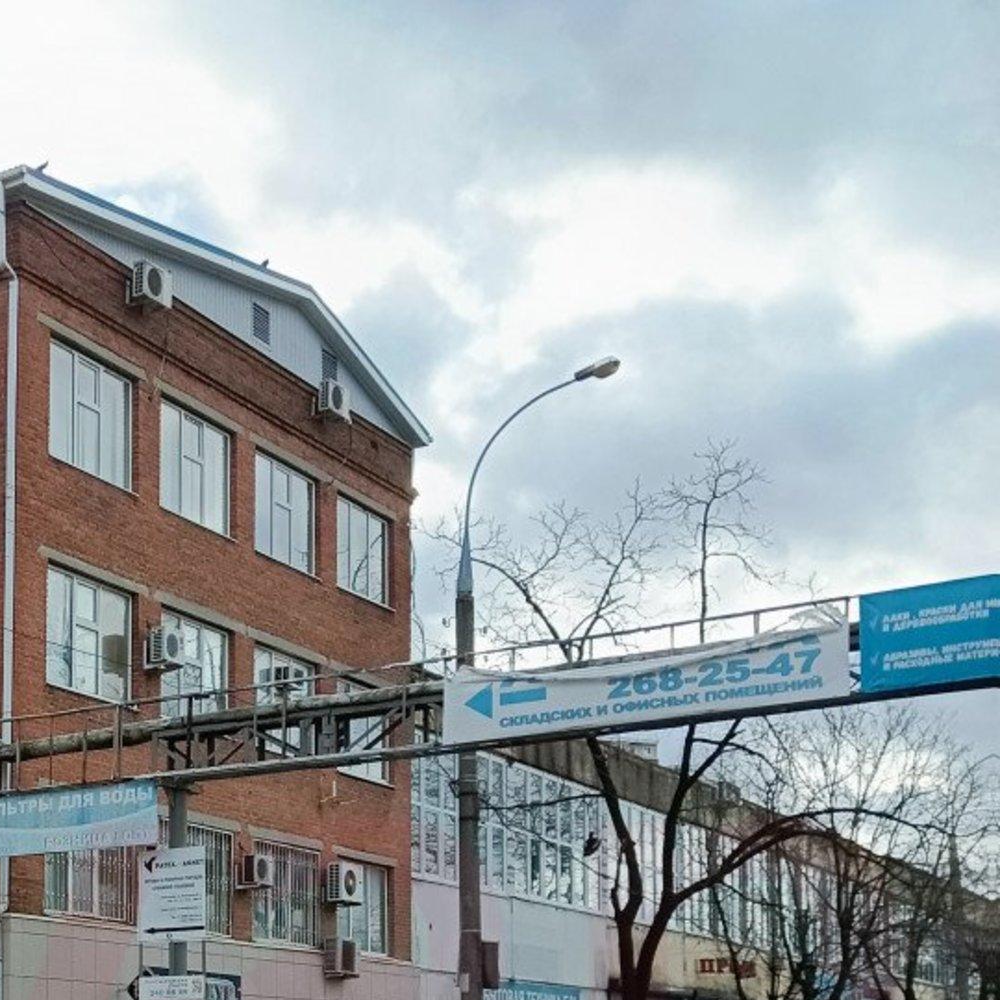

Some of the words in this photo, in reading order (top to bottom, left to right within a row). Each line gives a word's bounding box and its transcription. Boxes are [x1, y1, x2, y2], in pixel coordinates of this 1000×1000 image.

[608, 648, 821, 699] 268-25-47
[500, 706, 592, 729] СКЛАДСКИХ
[596, 704, 608, 716] И
[613, 691, 699, 715] ОФИСНЫХ
[705, 675, 823, 702] ПОМЕЩЕНИЙ
[59, 792, 94, 812] ДЛЯ
[100, 785, 153, 805] ВОДЫ
